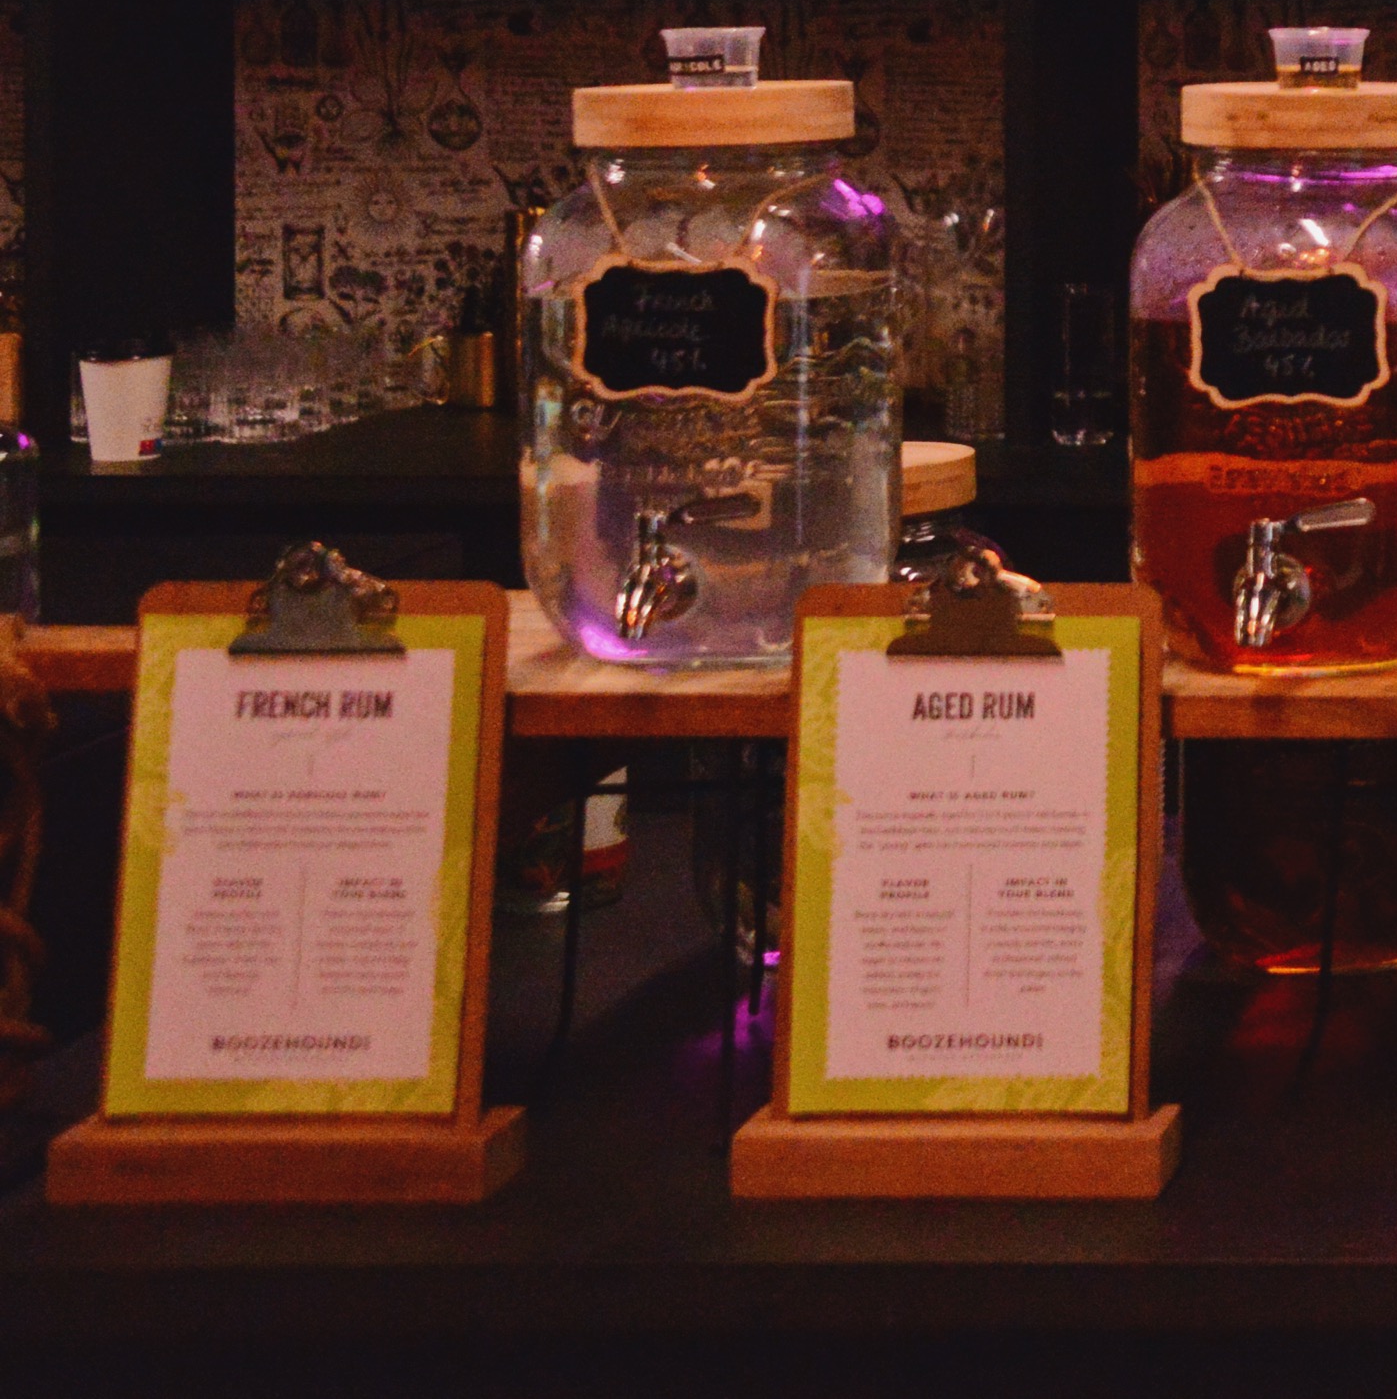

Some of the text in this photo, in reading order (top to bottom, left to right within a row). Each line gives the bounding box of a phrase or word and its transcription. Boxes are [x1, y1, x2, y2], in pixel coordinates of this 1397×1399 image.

[234, 690, 394, 719] FRENCH RUM
[911, 691, 1036, 720] AGED RUM
